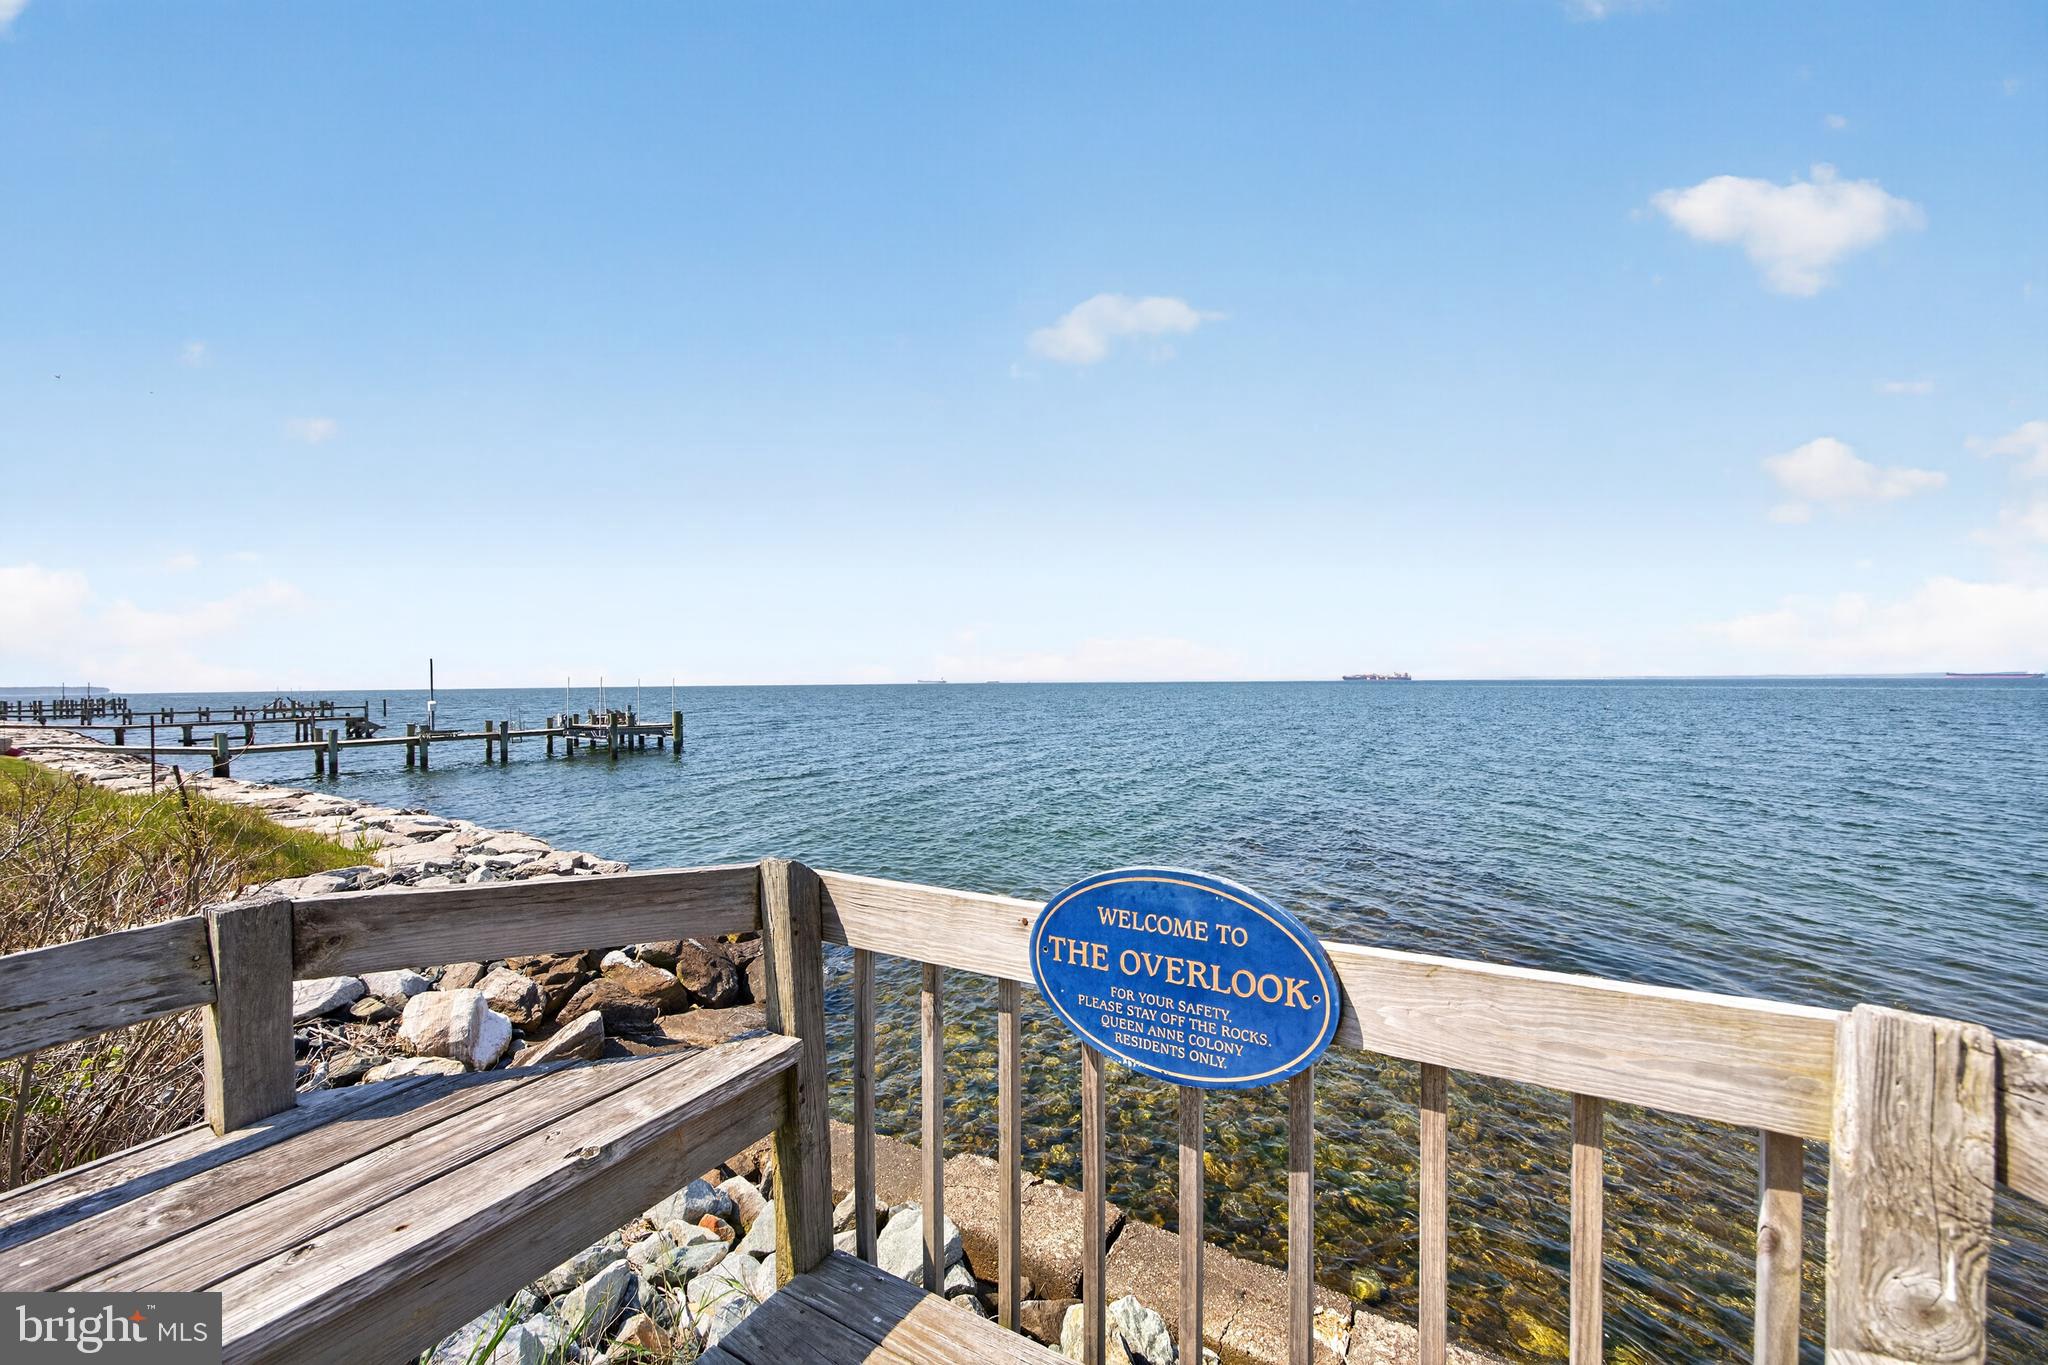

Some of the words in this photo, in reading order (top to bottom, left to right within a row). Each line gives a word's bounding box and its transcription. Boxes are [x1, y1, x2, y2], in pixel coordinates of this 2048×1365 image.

[1097, 906, 1208, 942] WELCOME
[1216, 923, 1248, 947] TO
[1048, 935, 1109, 972] THE
[1110, 986, 1135, 1001] FOR
[1139, 993, 1175, 1010] YOUR
[1078, 994, 1123, 1016] PLEASE
[1127, 1006, 1158, 1024] STAY
[1161, 1013, 1186, 1027] OFF
[1189, 1019, 1217, 1034] THE
[1221, 1025, 1272, 1047] ROCKS.
[1101, 1014, 1145, 1038] QUEEN
[1148, 1026, 1185, 1043] ANNE
[1188, 1033, 1244, 1057] COLONY
[1115, 1033, 1185, 1058] RESIDENTS
[1189, 1050, 1227, 1070] ONLY.
